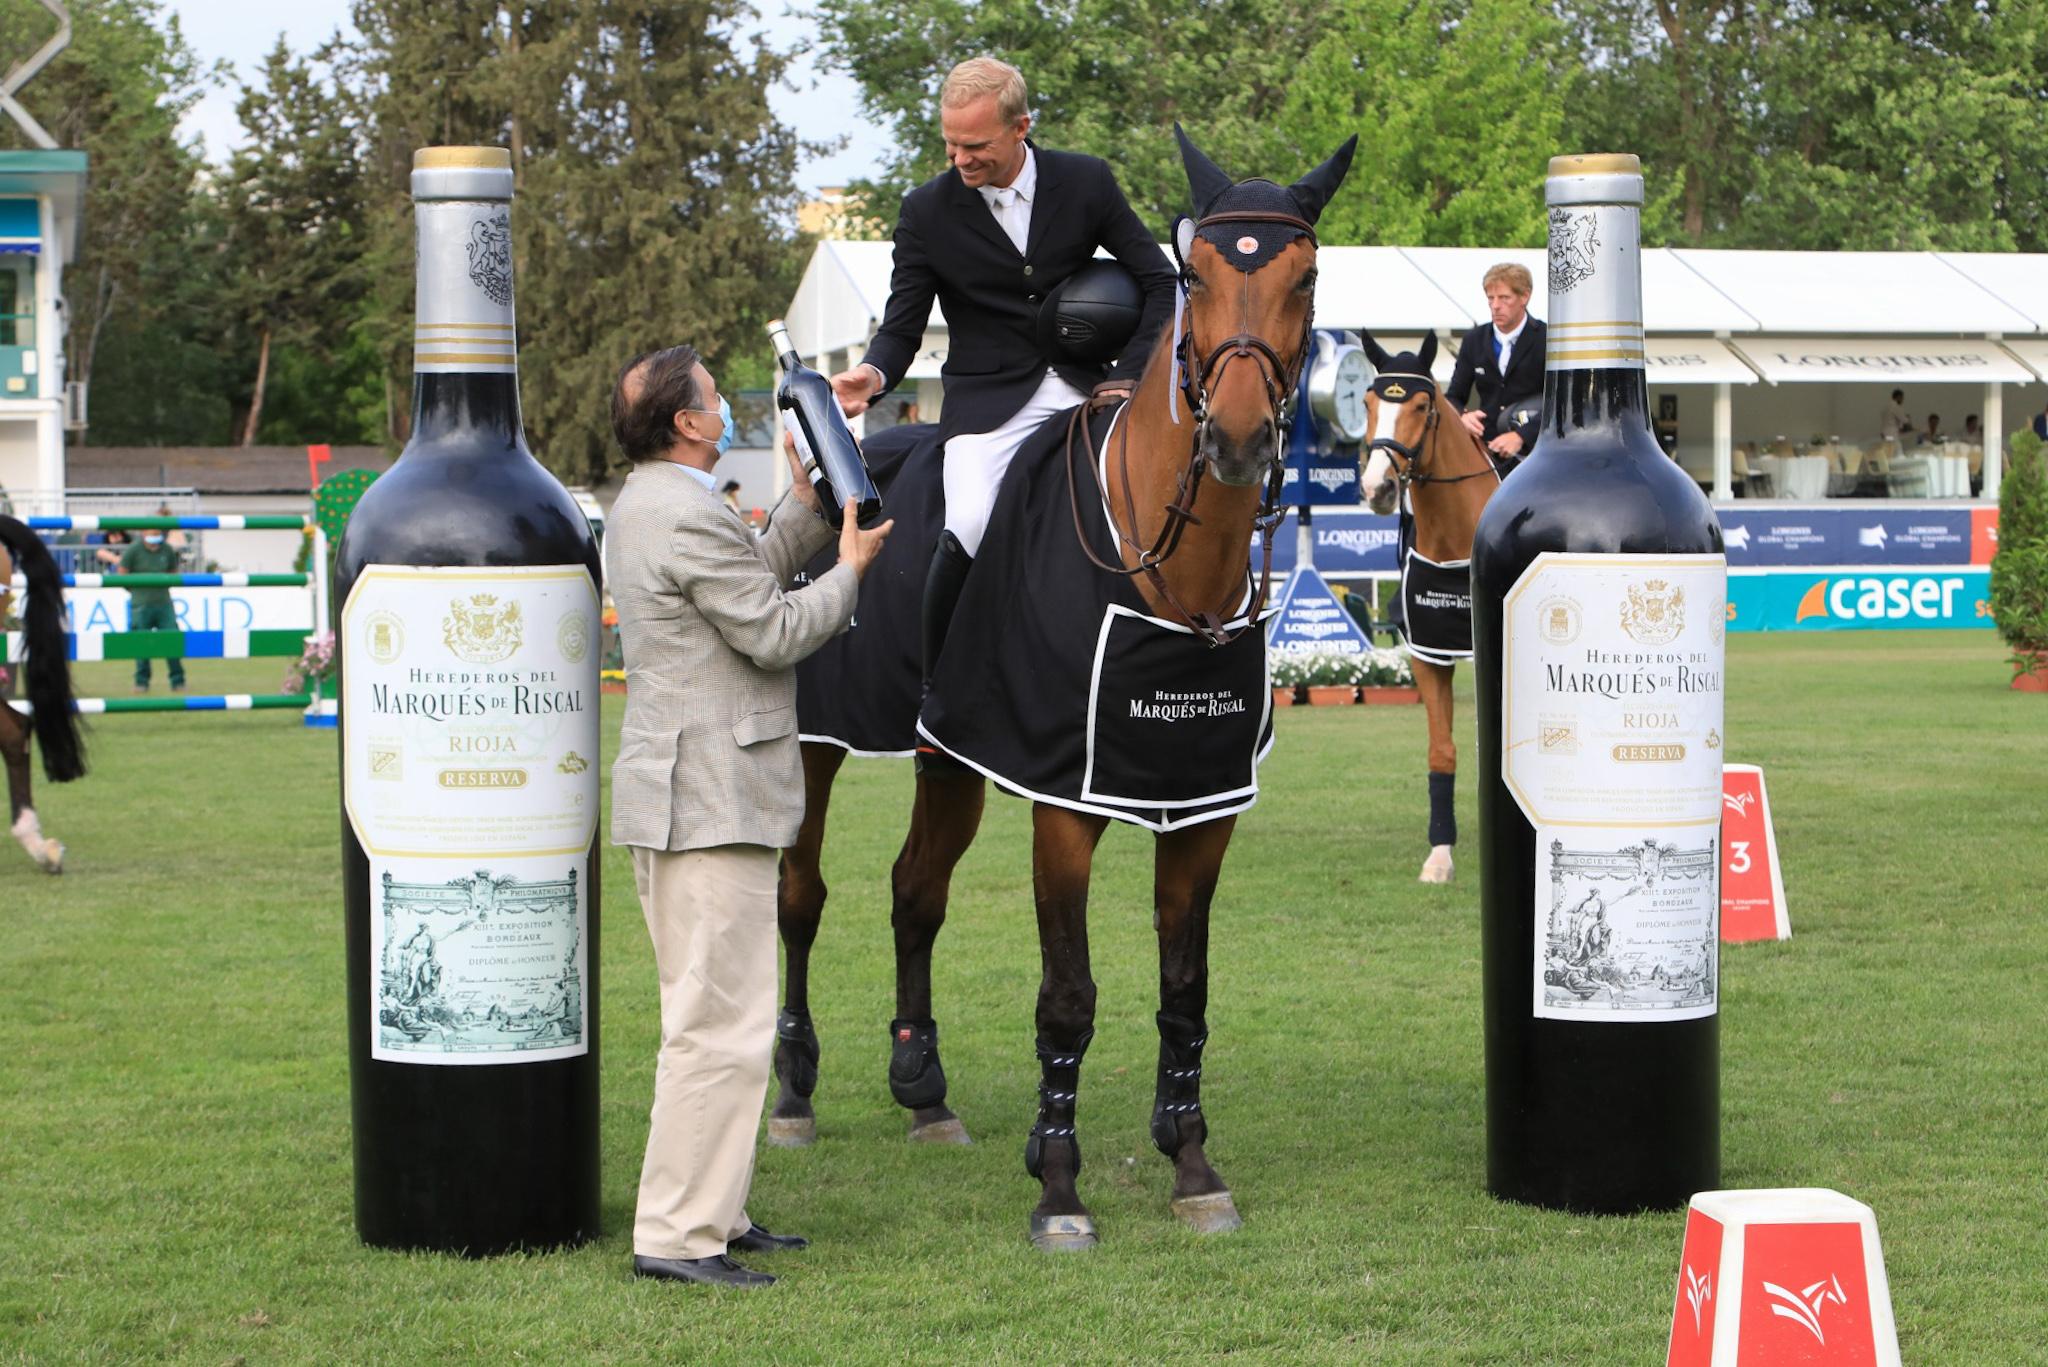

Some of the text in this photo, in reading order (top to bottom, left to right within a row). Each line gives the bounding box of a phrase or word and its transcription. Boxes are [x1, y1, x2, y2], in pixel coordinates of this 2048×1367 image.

[1774, 352, 1988, 367] LONGINES
[1308, 467, 1355, 483] LONGINES
[1830, 577, 1964, 619] caser
[1283, 623, 1348, 634] LONGINES
[1277, 640, 1361, 653] LONGINES
[1586, 649, 1707, 664] HEREDEROS DEL
[410, 668, 557, 684] HEREDEROS DEL
[1546, 663, 1720, 700] MARQUÉS DE RISCAL
[372, 683, 583, 722] MARQUÉS DE RISCAL
[1155, 690, 1232, 701] HEREDEROS DEL
[1129, 698, 1246, 723] MARQUÉS DE RISCAL
[1623, 712, 1679, 728] RIOJA
[449, 735, 517, 753] RIOJA
[1618, 746, 1681, 760] RESERVA
[445, 771, 521, 786] RESERVA
[1729, 841, 1752, 874] 3
